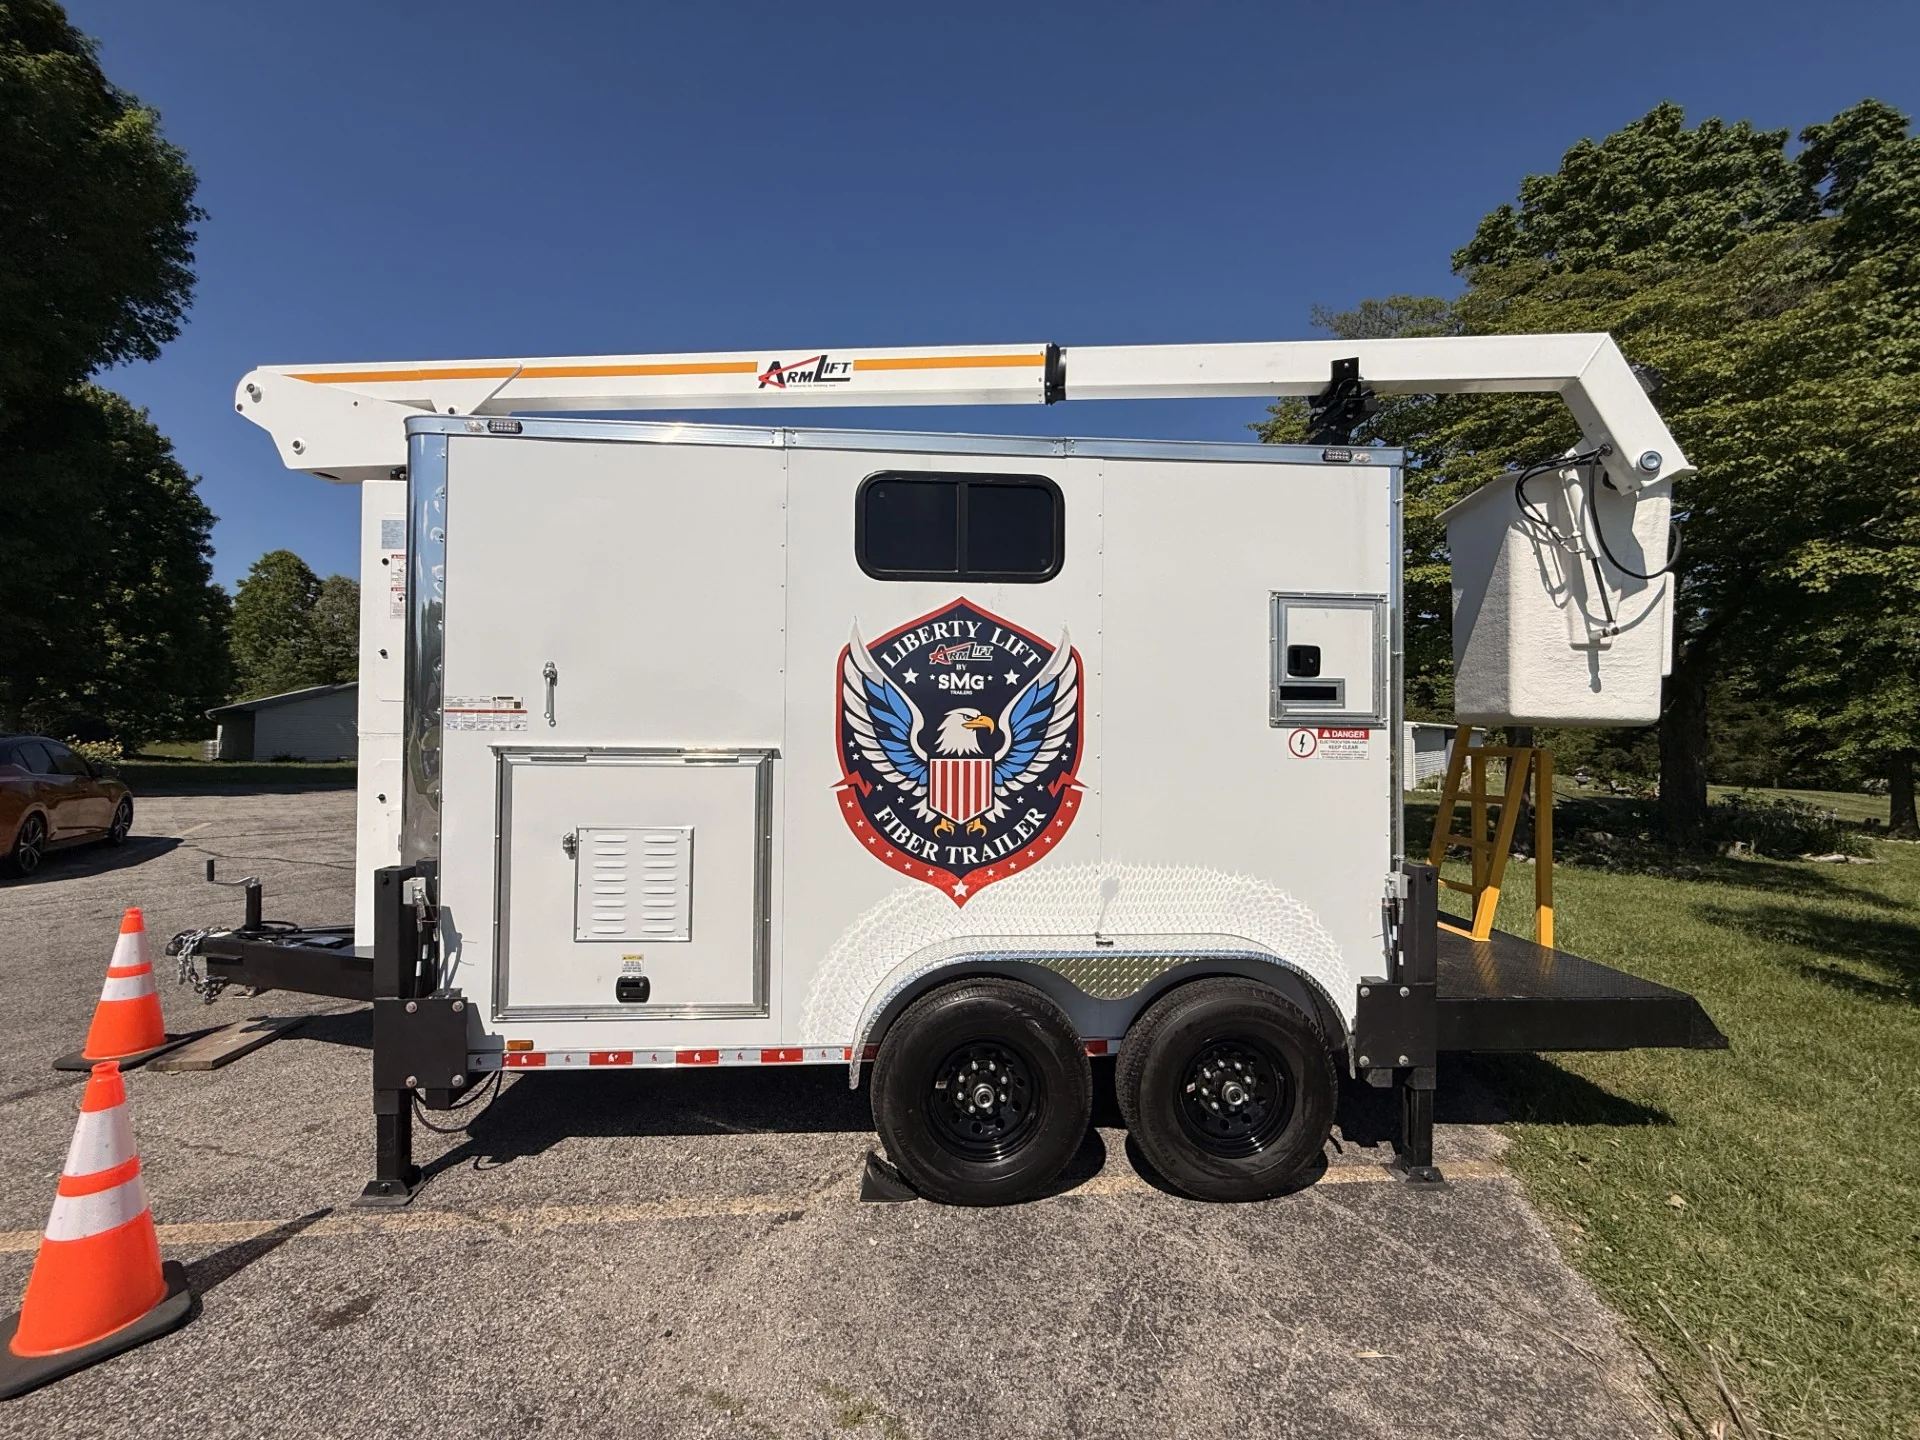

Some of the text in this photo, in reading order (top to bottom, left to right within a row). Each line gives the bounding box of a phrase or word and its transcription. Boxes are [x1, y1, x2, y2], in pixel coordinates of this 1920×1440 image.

[880, 620, 1042, 669] LIBERTY LIFT
[956, 663, 967, 671] BY
[938, 672, 985, 690] SMG
[1332, 730, 1365, 738] DANGER
[873, 804, 1048, 865] FIBER TRAILER
